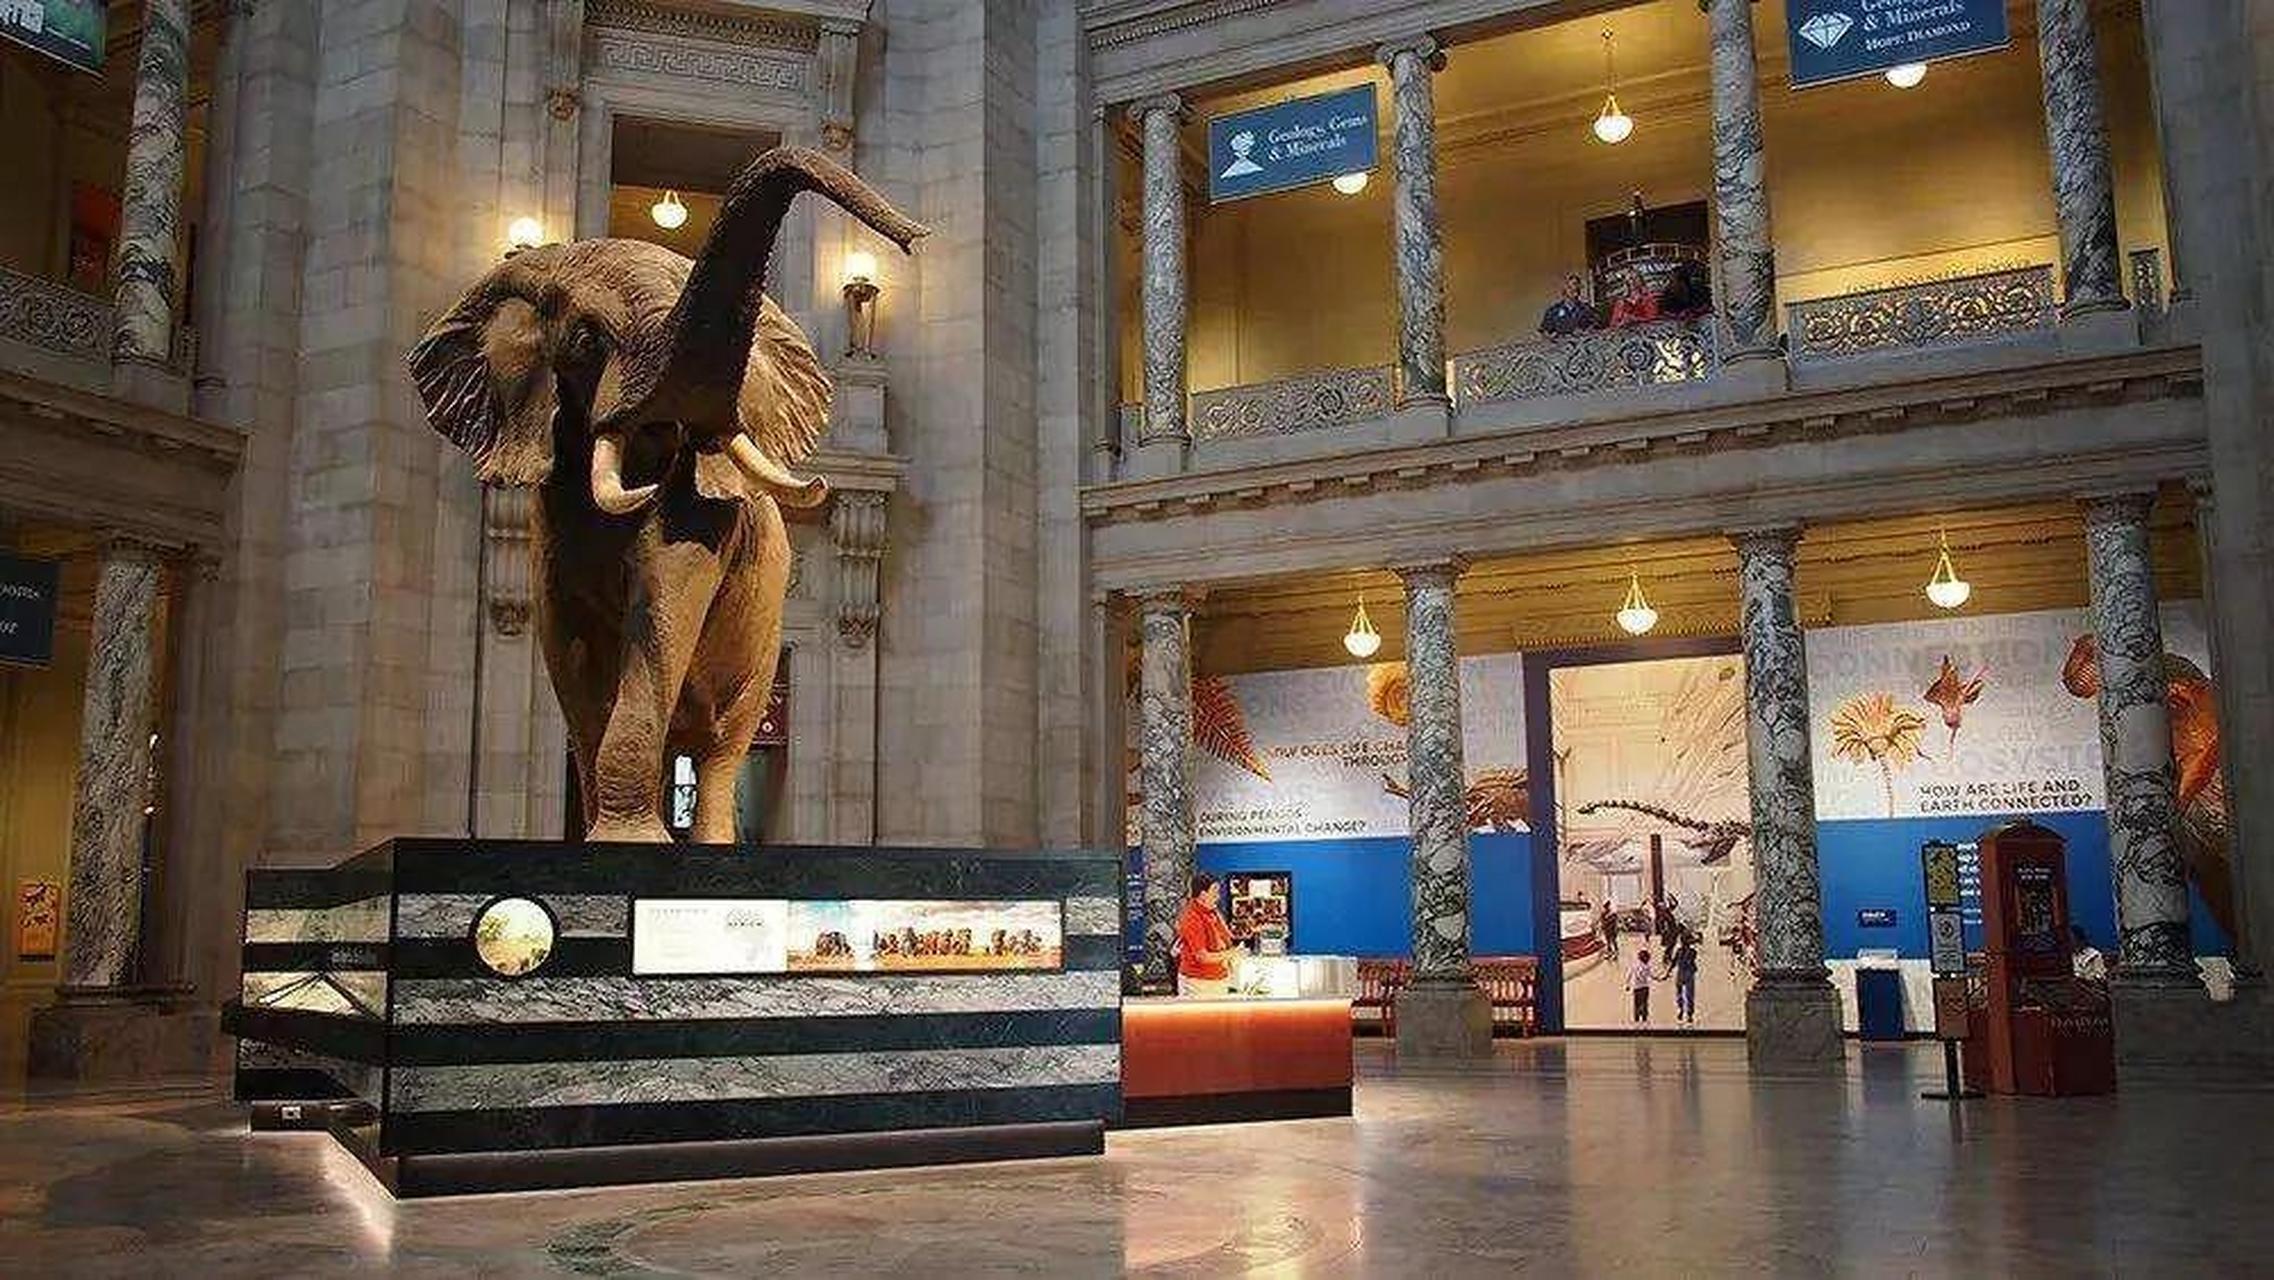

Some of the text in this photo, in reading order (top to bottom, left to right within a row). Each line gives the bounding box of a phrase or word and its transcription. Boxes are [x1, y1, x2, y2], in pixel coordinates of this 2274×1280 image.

[1863, 14, 1878, 31] &
[1884, 0, 1966, 27] Minerals
[1328, 115, 1367, 130] Gems
[1268, 133, 1347, 161] & Minerals
[1920, 779, 2081, 798] HOW ARE LIFE AND
[1921, 793, 2092, 814] EARTH CONNECTED?
[1199, 819, 1366, 837] ENVIRONMENTAL CHANGE?
